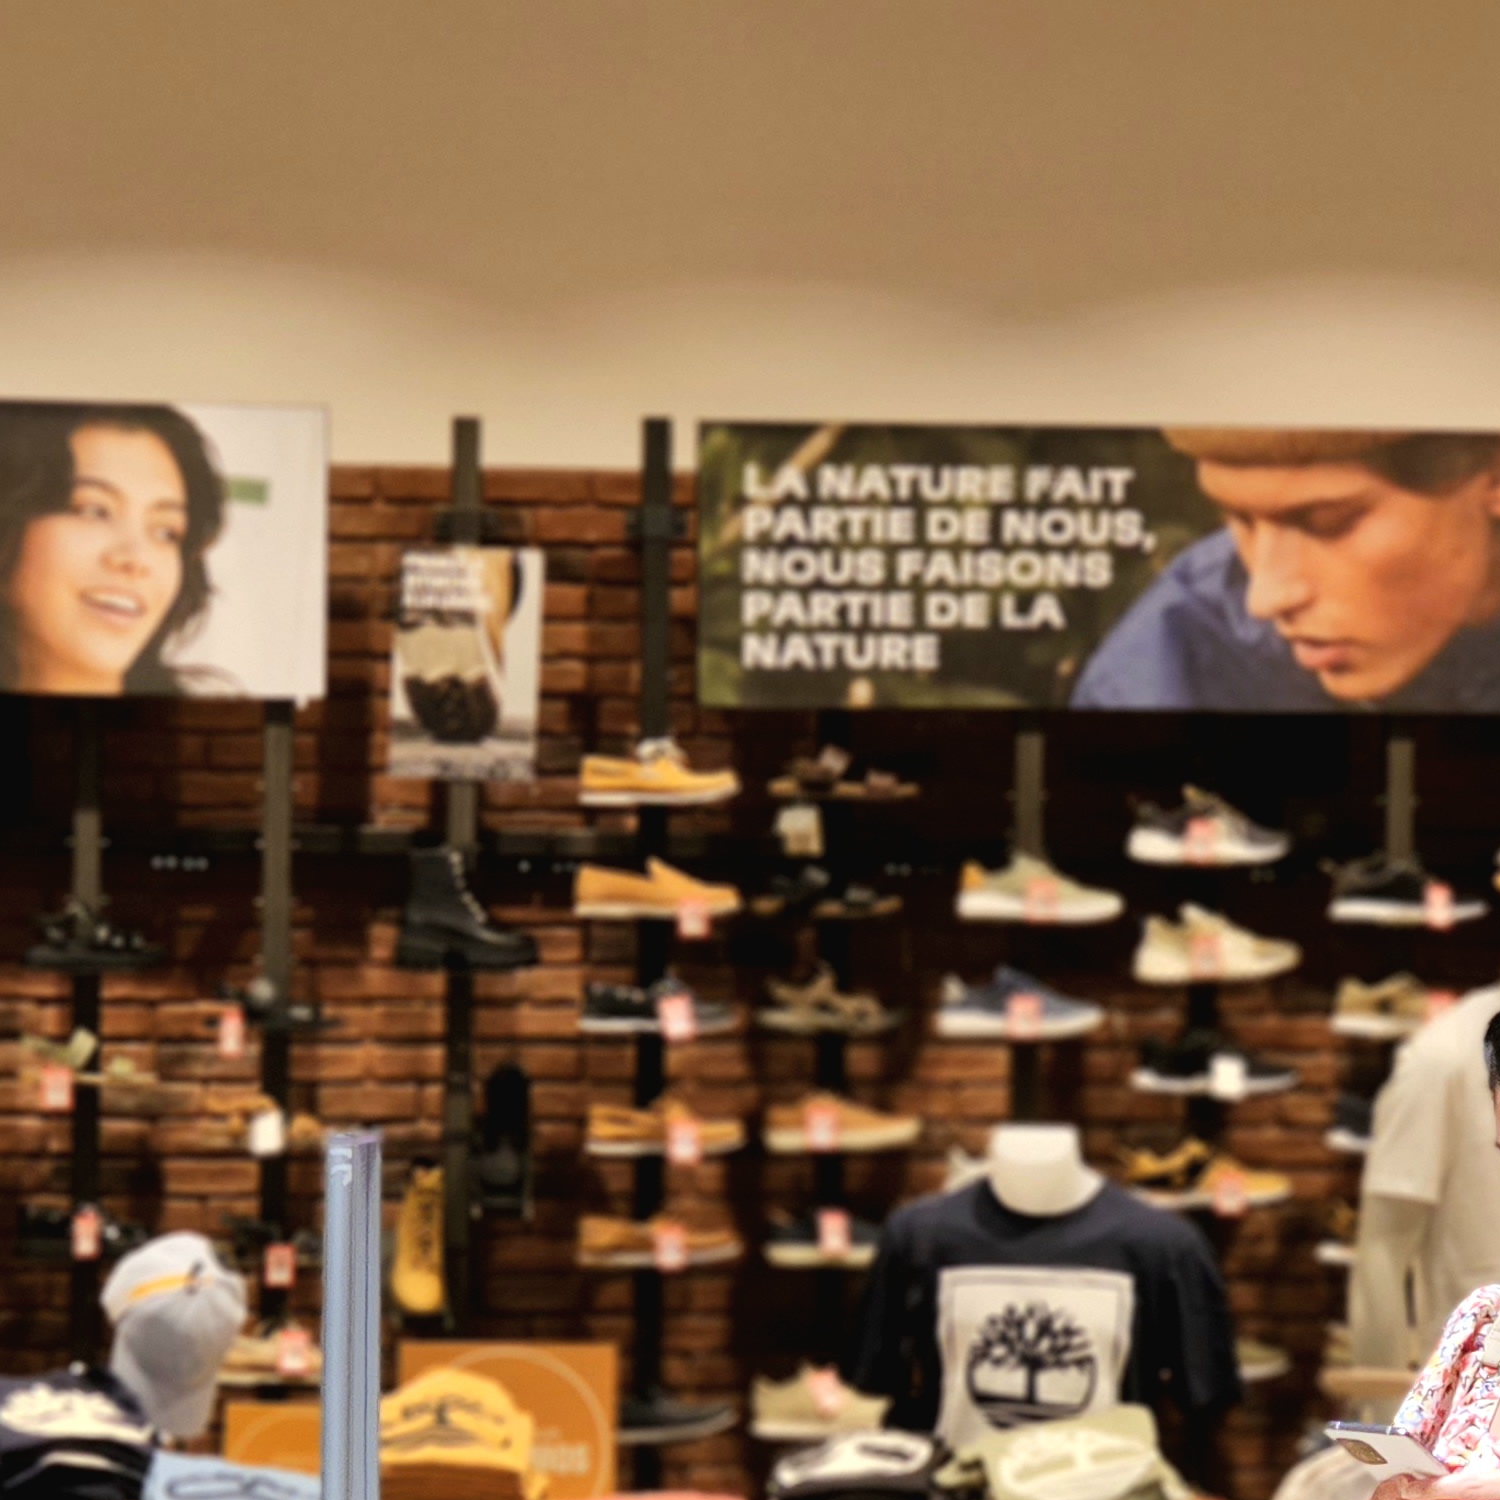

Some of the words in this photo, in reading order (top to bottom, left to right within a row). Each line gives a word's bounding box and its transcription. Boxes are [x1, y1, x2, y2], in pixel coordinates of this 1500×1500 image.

[743, 465, 808, 501] LA
[817, 464, 1015, 503] NATURE
[1023, 466, 1135, 504] FAIT
[743, 506, 915, 543] PARTIE
[925, 507, 991, 544] DE
[1002, 510, 1157, 553] NOUS,
[743, 548, 885, 586] NOUS
[896, 550, 1113, 589] FAISONS
[743, 591, 914, 628] PARTIE
[925, 592, 989, 629] DE
[999, 593, 1066, 630] LA
[743, 634, 939, 671] NATURE
